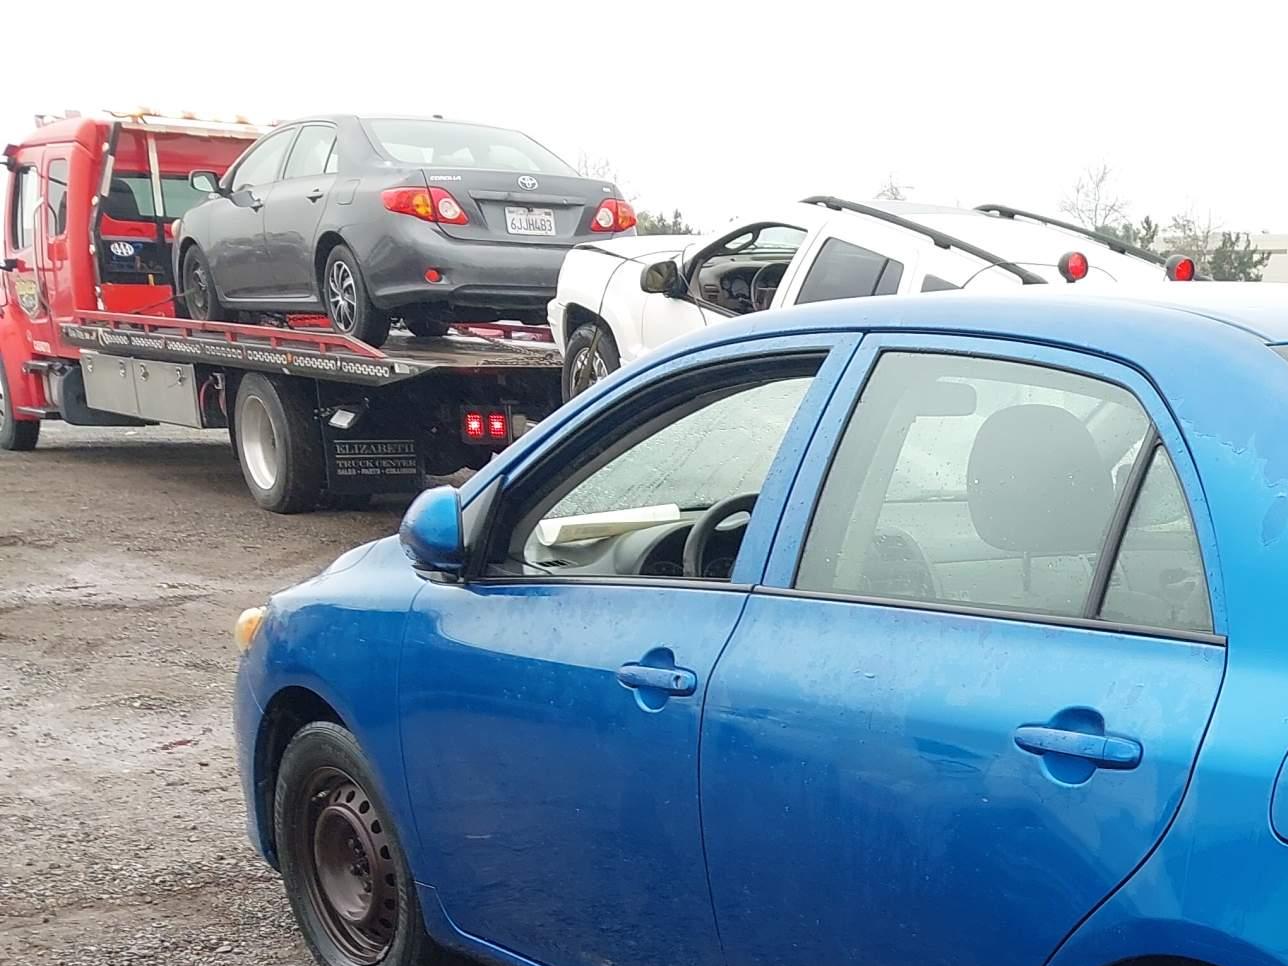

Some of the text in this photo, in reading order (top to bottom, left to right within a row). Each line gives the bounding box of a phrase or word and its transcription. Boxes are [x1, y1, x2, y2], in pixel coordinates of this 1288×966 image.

[335, 443, 415, 455] ELIZABETH
[336, 459, 417, 468] TRUCK CENTER
